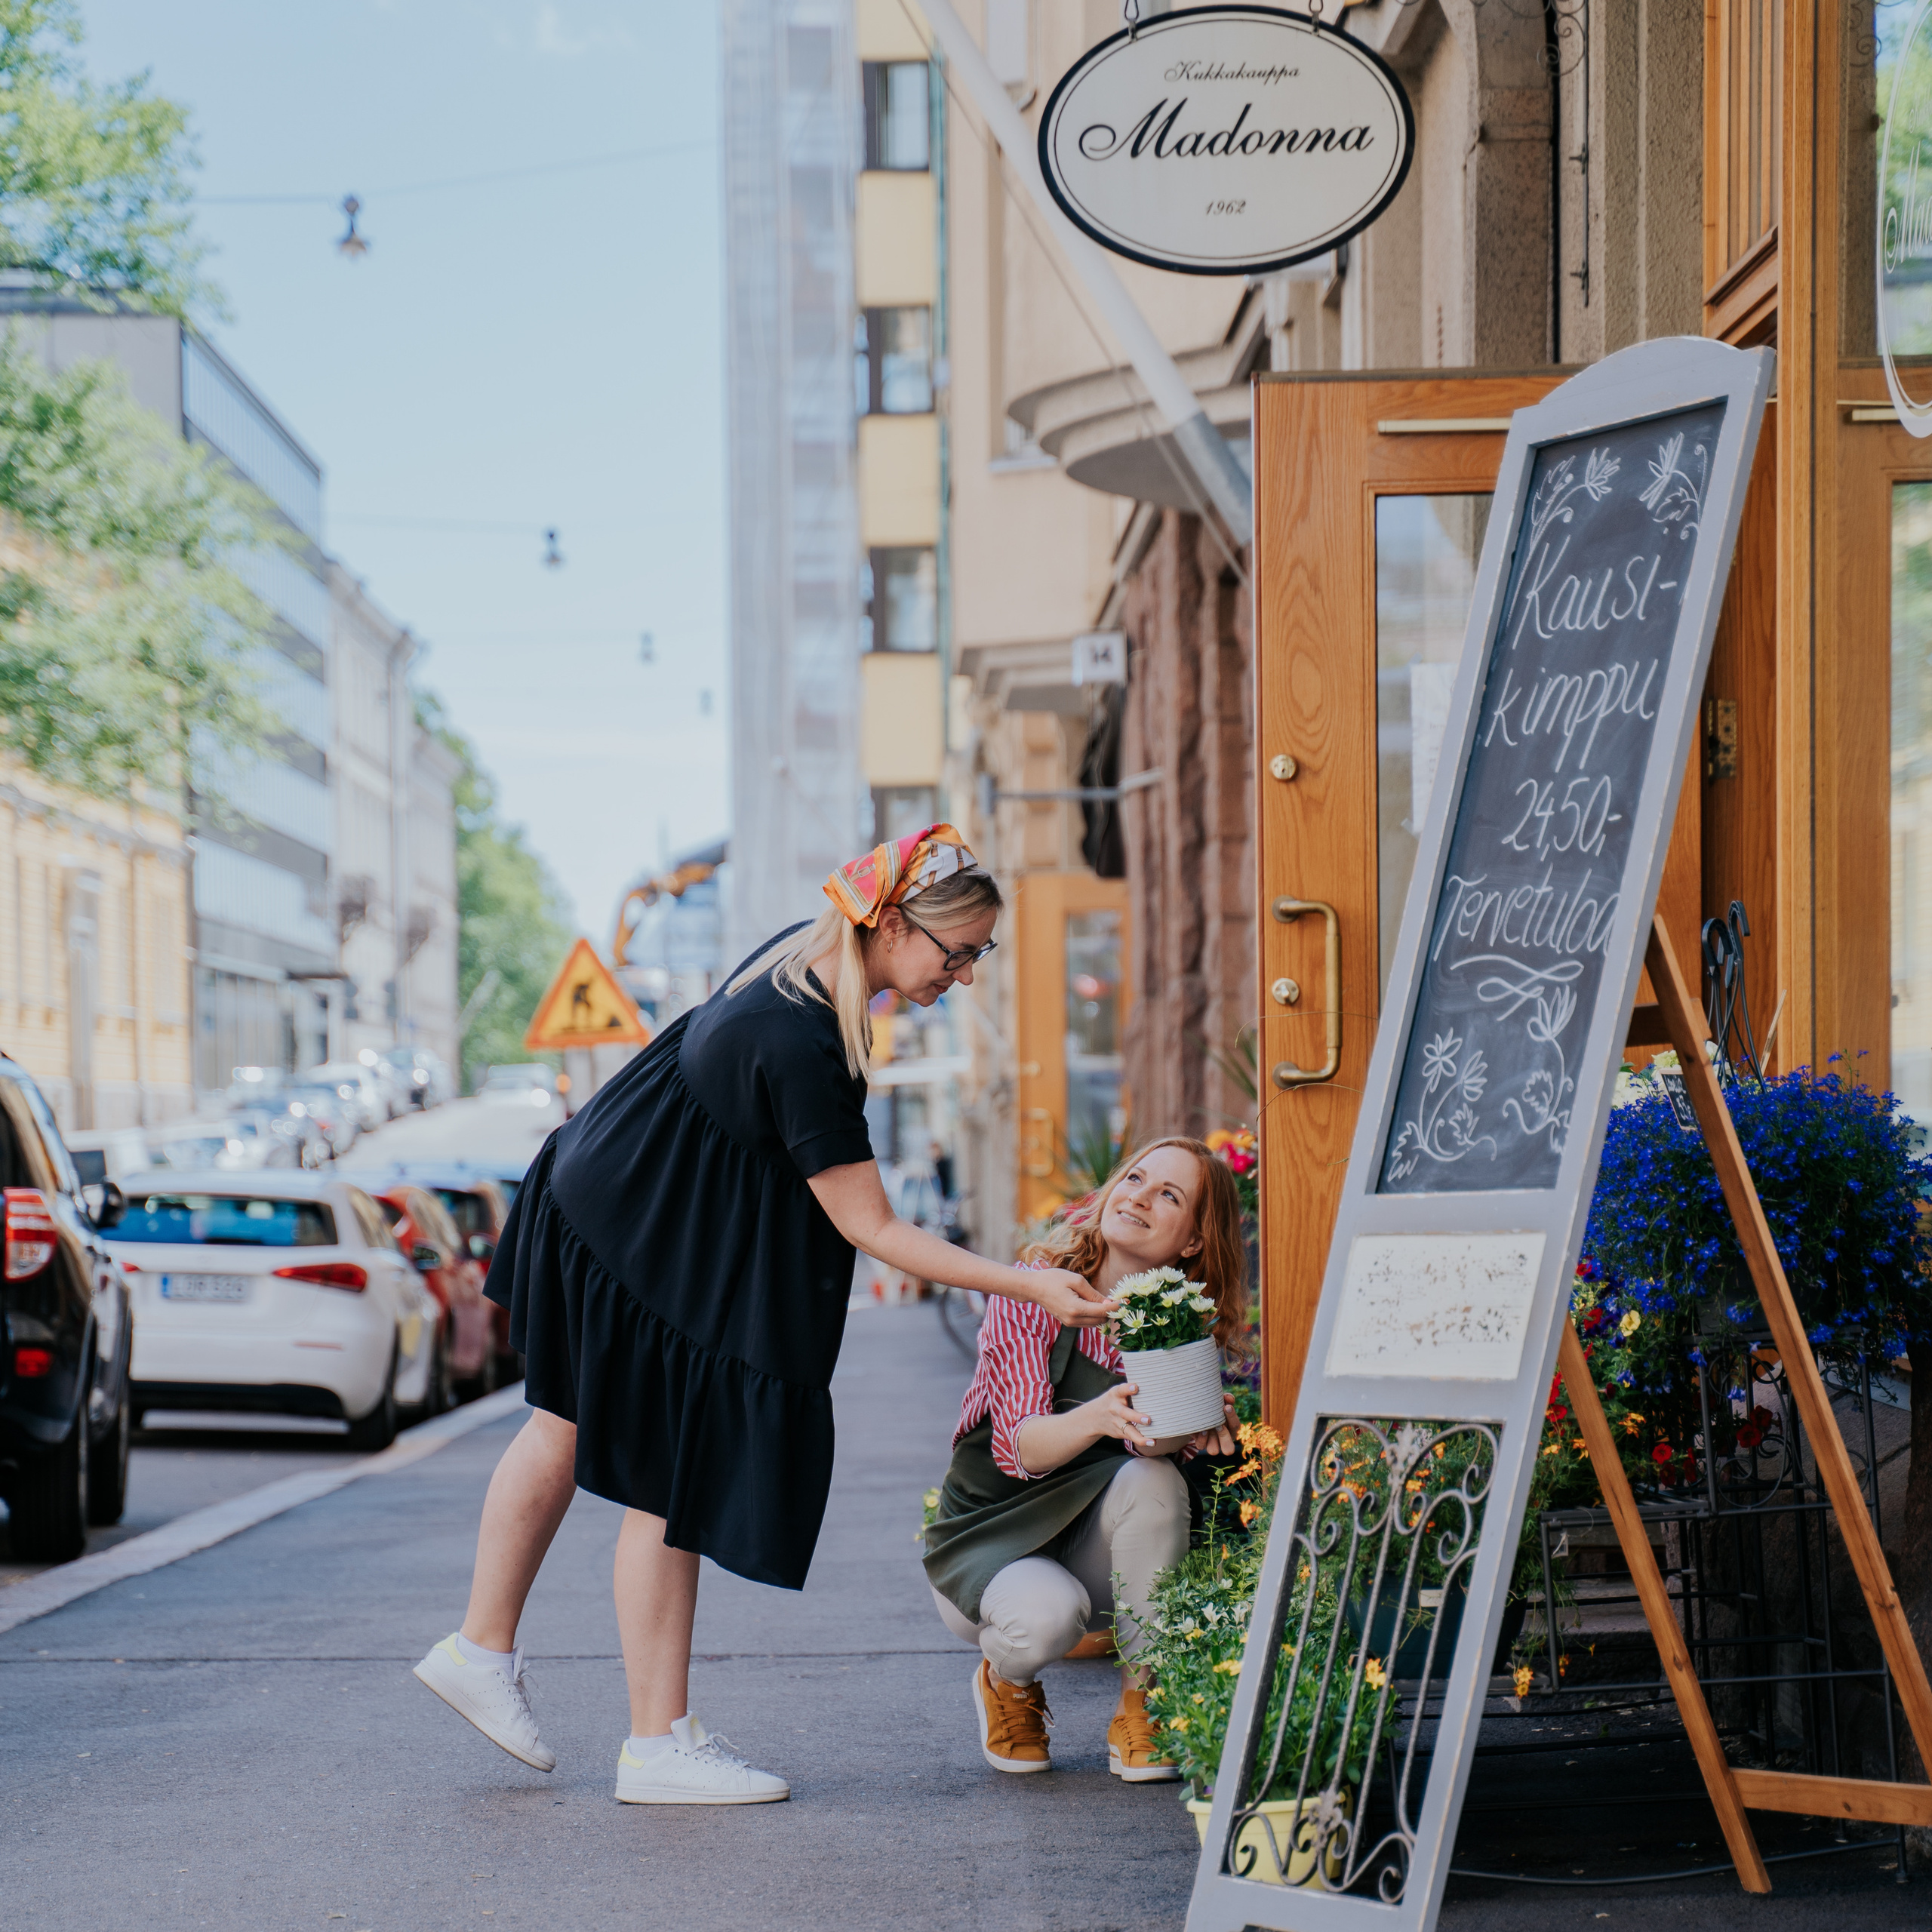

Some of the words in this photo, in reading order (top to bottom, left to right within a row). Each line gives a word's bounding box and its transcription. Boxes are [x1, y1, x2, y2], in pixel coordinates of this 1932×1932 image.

[1164, 61, 1301, 85] Kukkakauppa
[1078, 97, 1374, 161] Madonna
[1204, 198, 1247, 216] 1962
[1432, 863, 1621, 962] Tervetuloa
